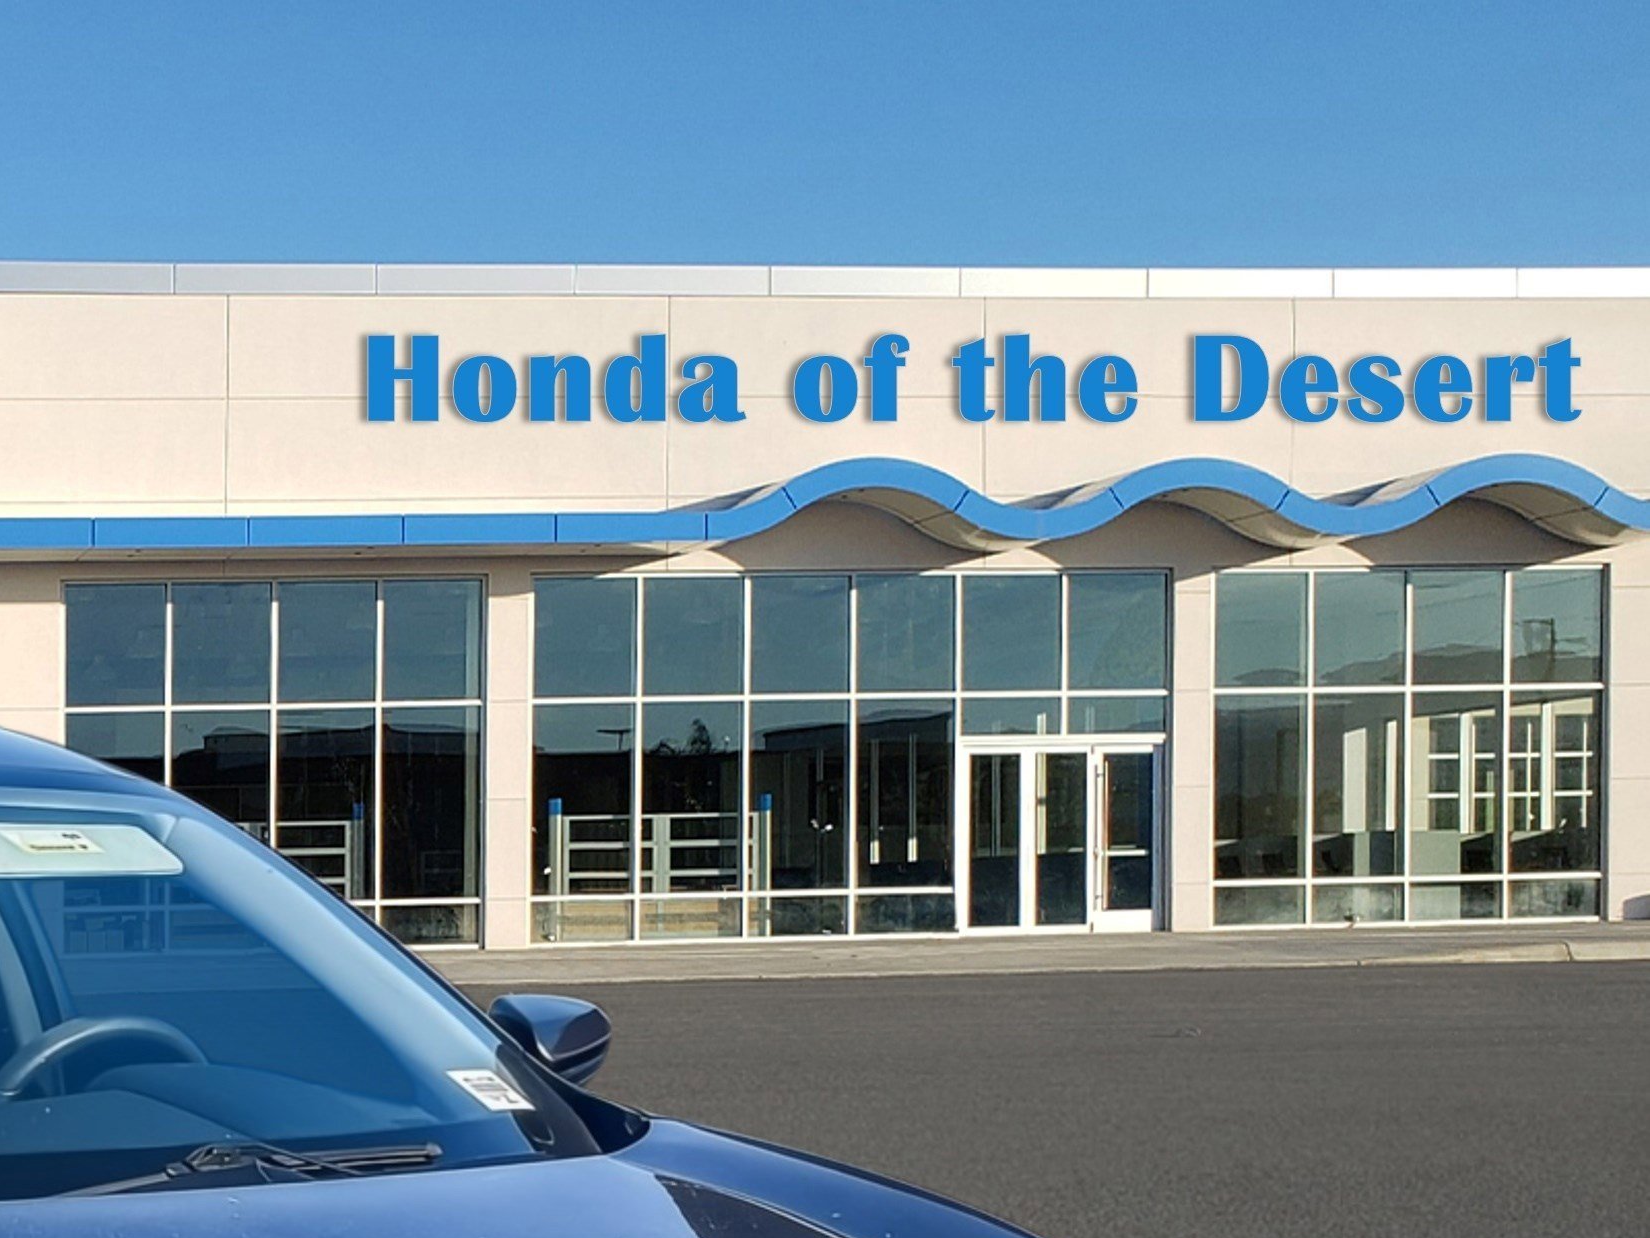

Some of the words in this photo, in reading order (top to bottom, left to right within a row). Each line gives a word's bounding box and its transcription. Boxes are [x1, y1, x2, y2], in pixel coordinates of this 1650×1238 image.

[365, 332, 748, 424] Honda
[792, 332, 911, 424] of
[951, 332, 1139, 424] the
[1193, 334, 1583, 424] Desert
